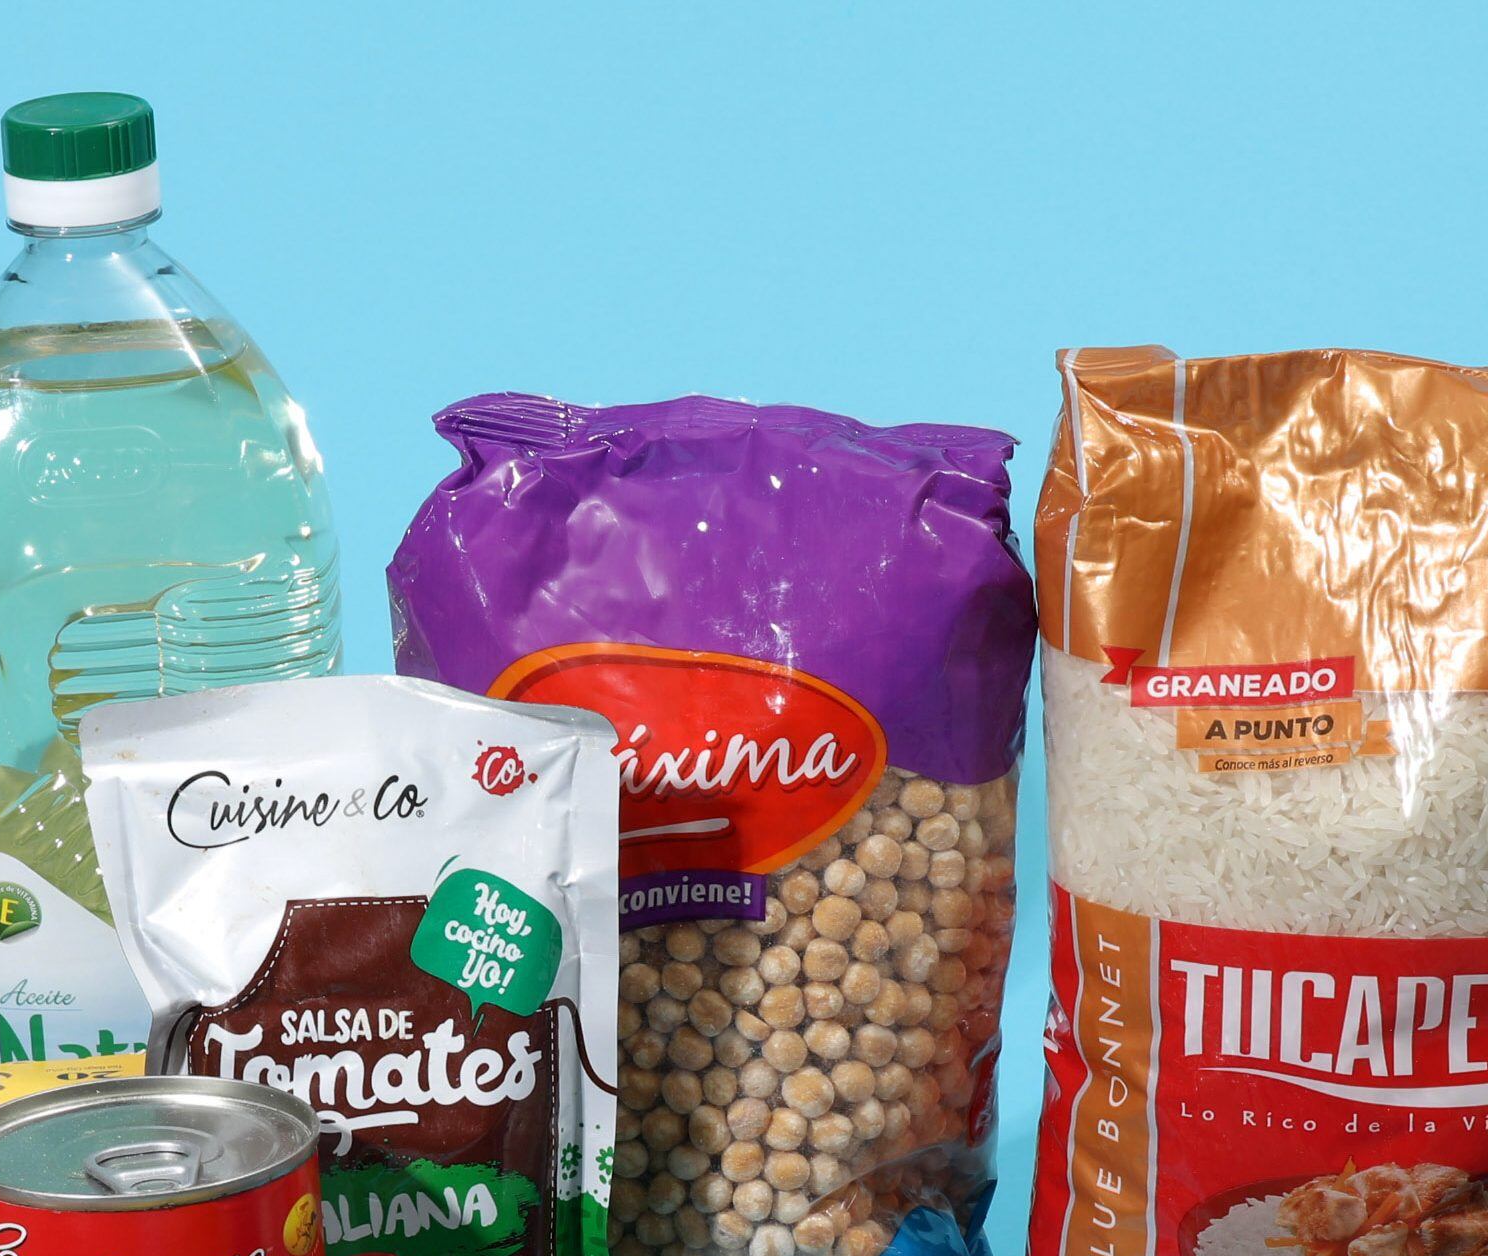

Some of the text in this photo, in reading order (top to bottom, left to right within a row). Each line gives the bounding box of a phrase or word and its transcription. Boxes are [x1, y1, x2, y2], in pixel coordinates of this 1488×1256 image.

[1146, 668, 1336, 699] GRANEADO
[1205, 713, 1335, 741] A PUNTO
[482, 751, 522, 790] Co
[620, 724, 856, 795] áxima
[1215, 754, 1333, 770] Conoce más al reverso
[167, 770, 427, 849] Cuisine & Co
[0, 898, 19, 926] E
[16, 887, 39, 922] VITAMINA
[472, 882, 532, 937] Hoy,
[620, 876, 751, 915] conviene!
[445, 921, 524, 963] cocino
[0, 979, 76, 1007] Aceite
[281, 1008, 413, 1045] SALSA DE
[1097, 934, 1128, 1143] BONNET
[203, 1018, 542, 1112] Tomates
[1181, 1102, 1215, 1121] Lo
[1344, 1113, 1380, 1133] de
[1408, 1113, 1437, 1133] la
